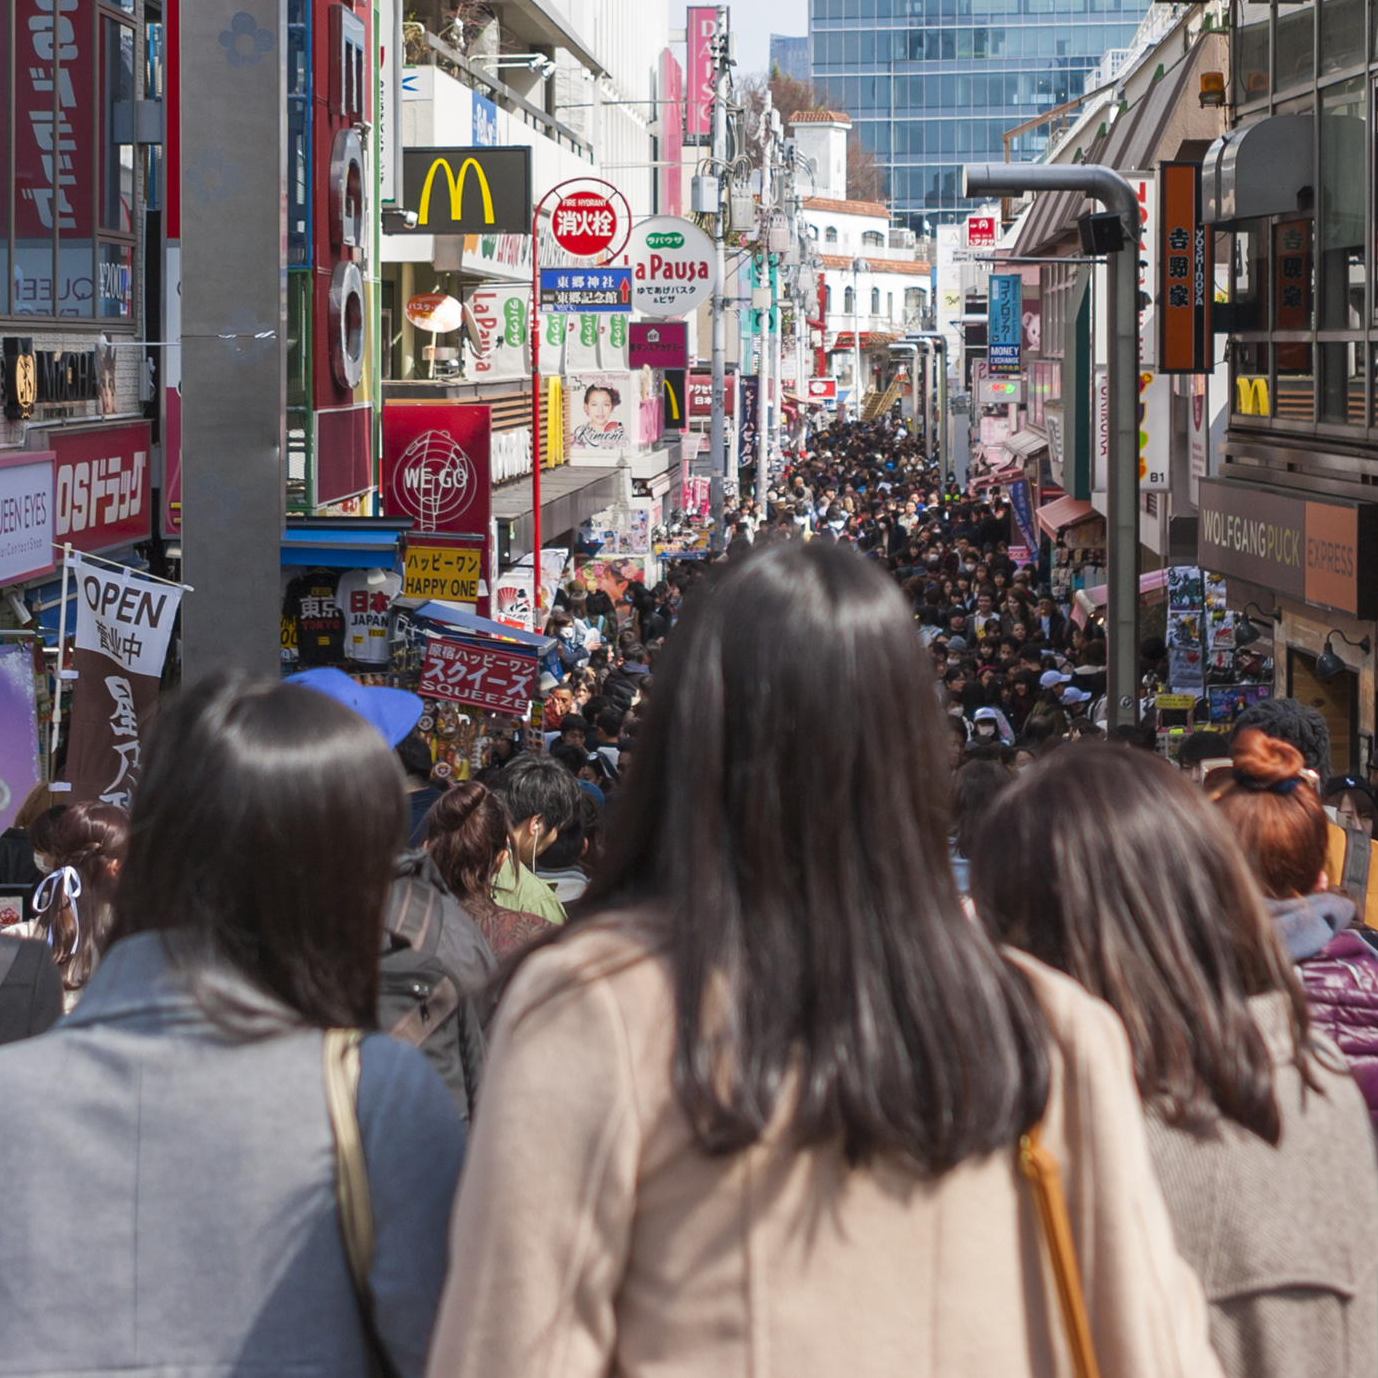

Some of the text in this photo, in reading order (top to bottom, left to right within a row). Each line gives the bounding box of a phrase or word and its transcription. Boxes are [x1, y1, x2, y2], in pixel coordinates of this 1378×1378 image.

[562, 198, 607, 208] FIRE HYDRANT
[557, 210, 614, 237] 消火栓
[556, 275, 615, 289] 東郷神社
[650, 253, 709, 283] Pausa
[1167, 226, 1191, 310] 吉野家
[990, 346, 1020, 357] MONEY
[1150, 472, 1165, 483] B1
[23, 490, 48, 527] EYES
[55, 450, 147, 537] OSドラッグ
[1202, 508, 1301, 568] WOLFGANG PUCK
[407, 553, 479, 573] ハッピーワン
[1307, 537, 1354, 579] EXPRESS
[83, 575, 168, 629] OPEN
[350, 590, 391, 614] 日本
[405, 578, 477, 598] HAPPY ONE
[350, 613, 390, 628] JAPAN
[427, 642, 536, 675] 原宿ハッピーワン
[424, 658, 533, 700] スクイーズ
[421, 680, 527, 710] SQUEEZE
